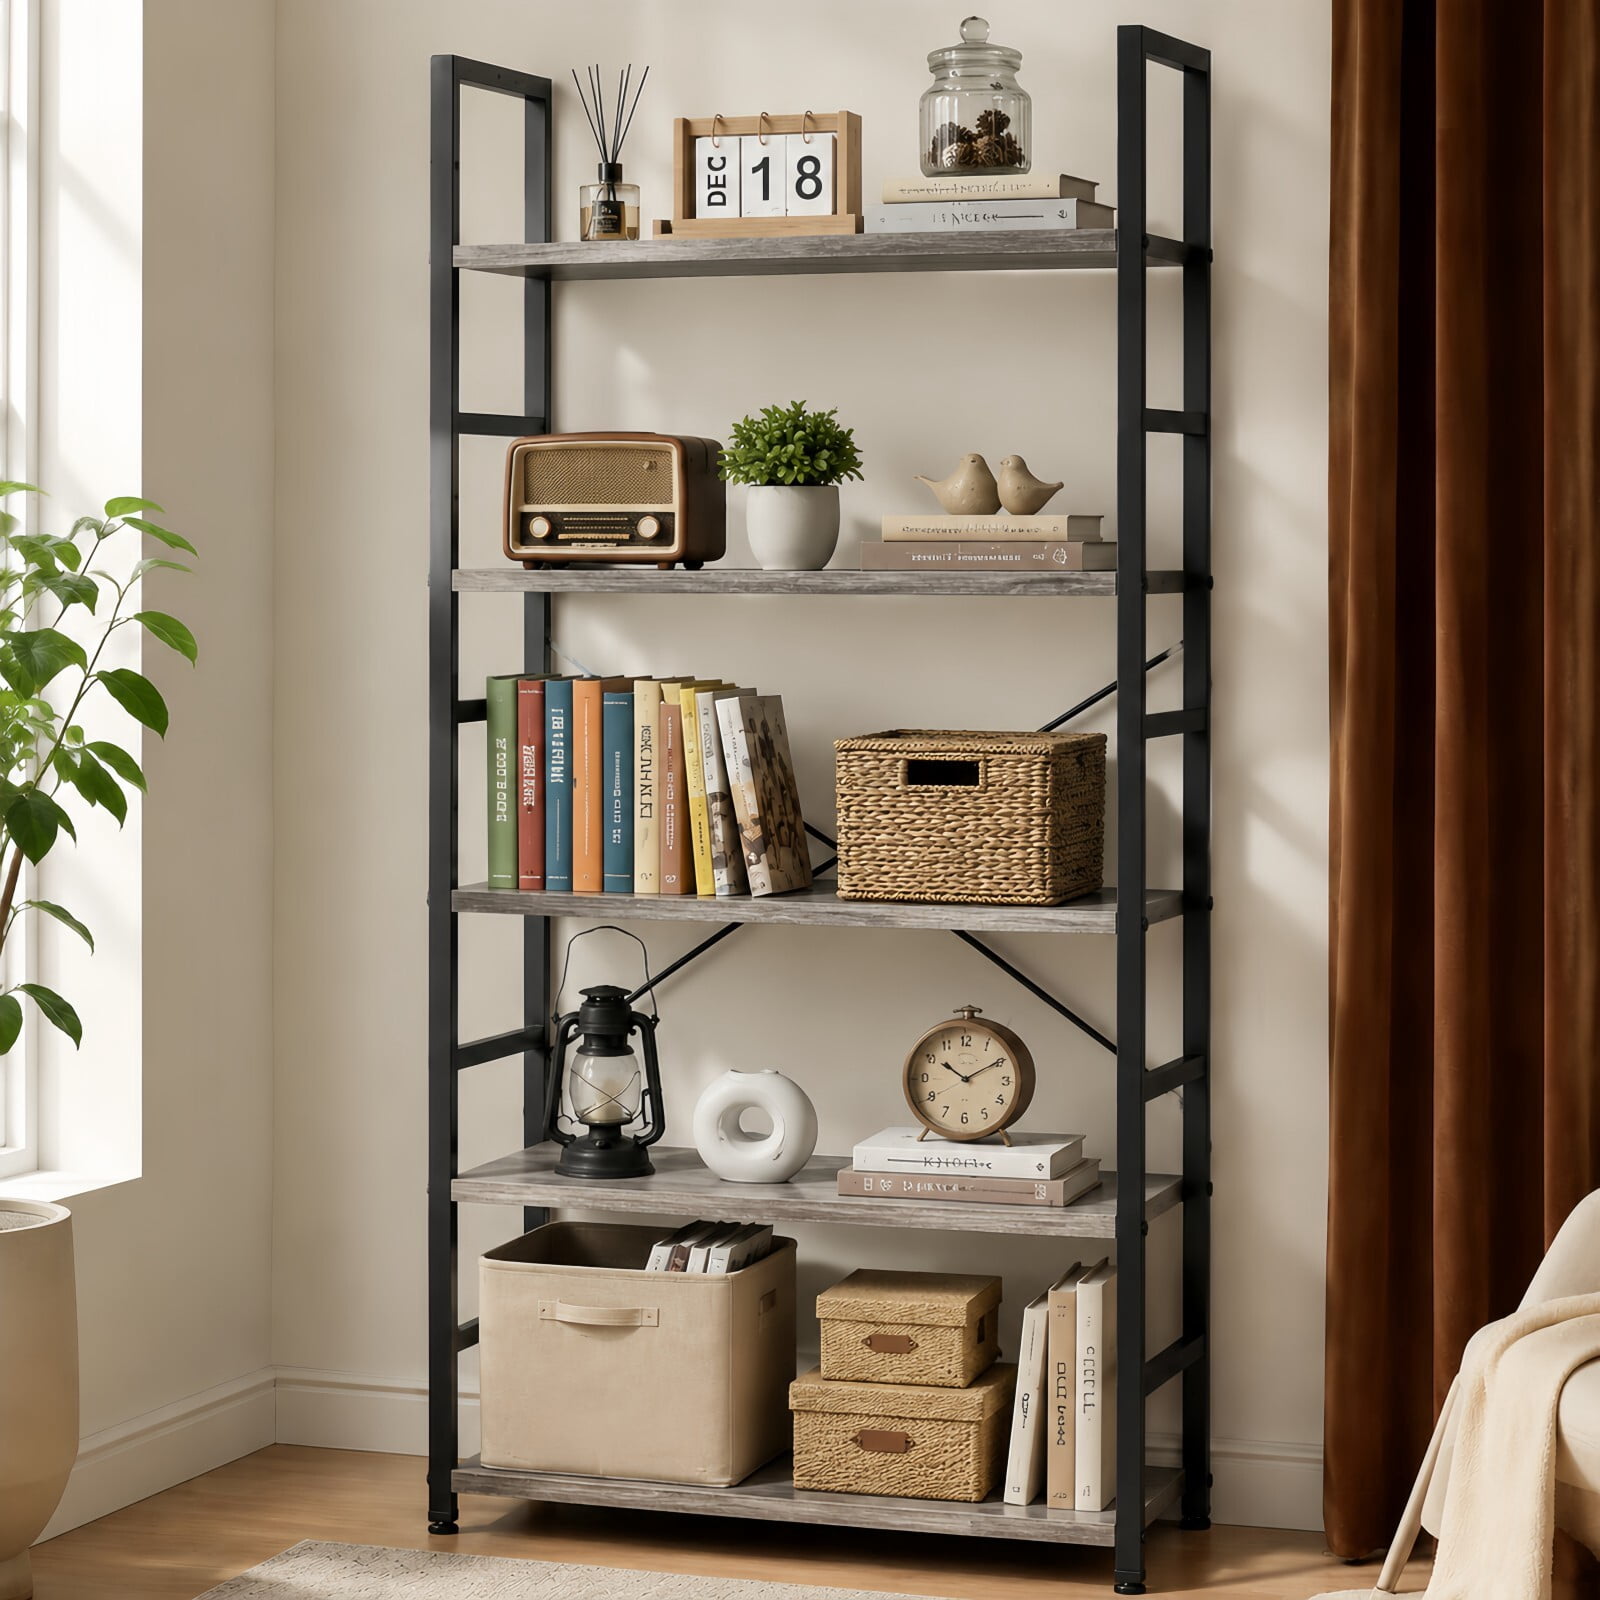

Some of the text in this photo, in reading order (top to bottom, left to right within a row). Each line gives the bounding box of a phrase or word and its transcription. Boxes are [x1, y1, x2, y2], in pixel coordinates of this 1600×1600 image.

[707, 156, 726, 206] DEC
[960, 1035, 972, 1047] 12
[1001, 1076, 1011, 1086] 3
[942, 1105, 950, 1118] 7
[980, 1107, 989, 1120] 5
[960, 1112, 969, 1124] 6
